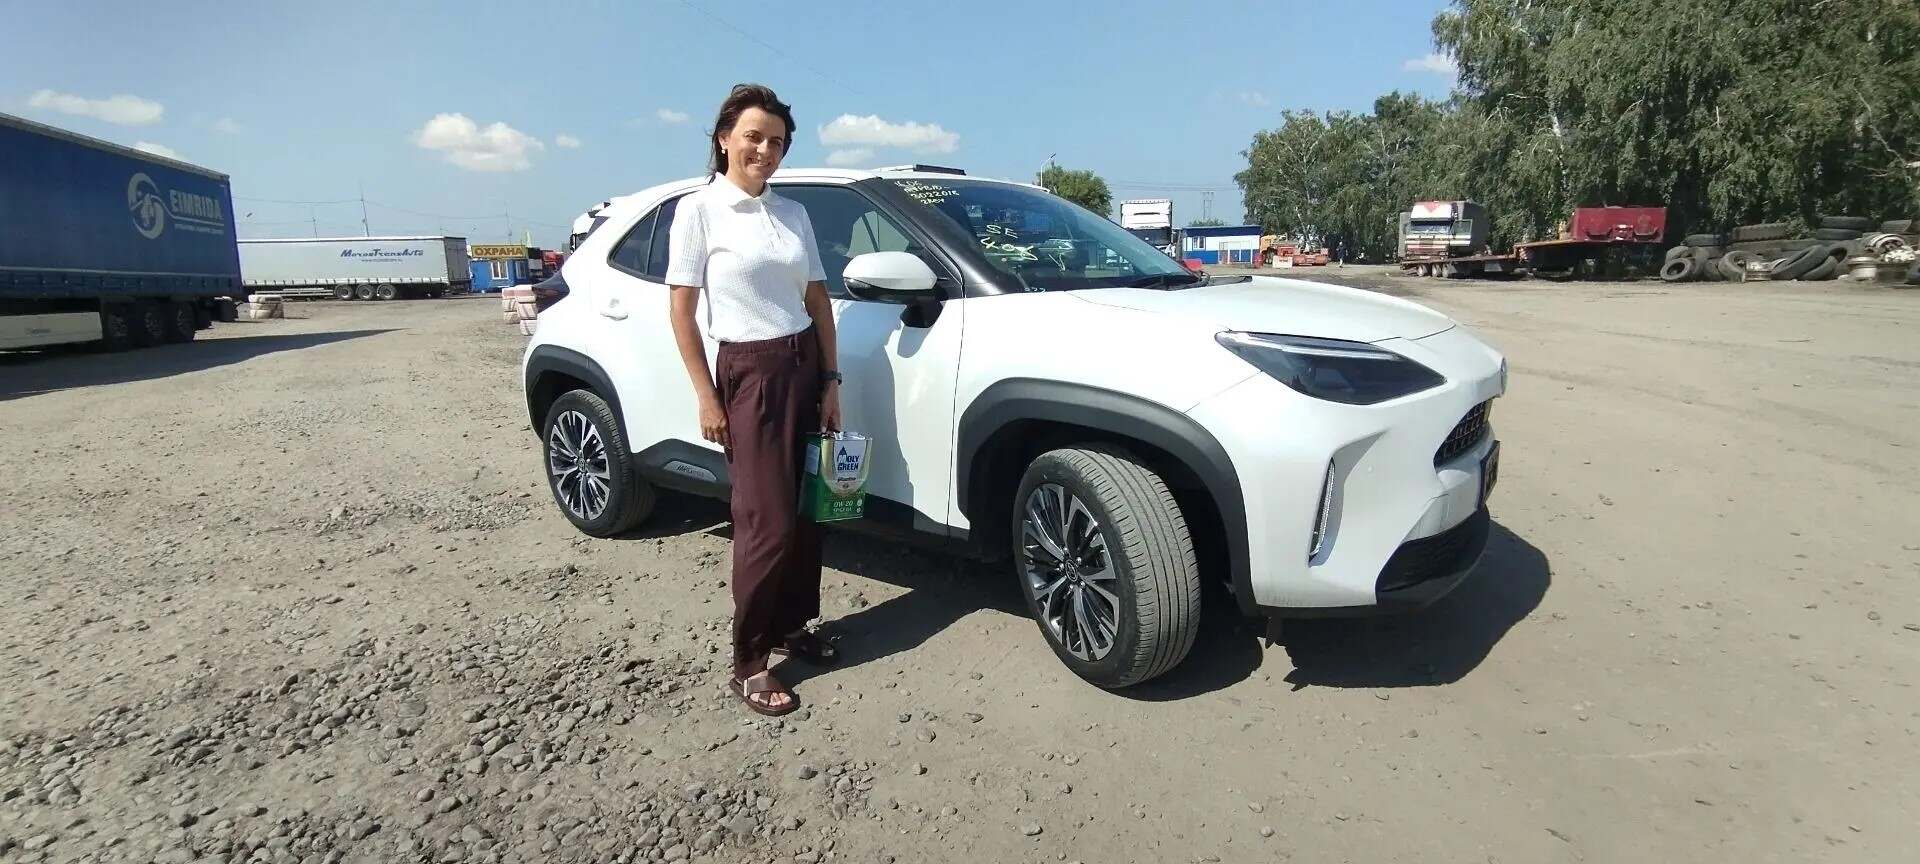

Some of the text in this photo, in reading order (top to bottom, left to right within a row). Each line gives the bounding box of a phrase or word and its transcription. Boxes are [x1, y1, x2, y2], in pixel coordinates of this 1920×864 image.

[170, 189, 224, 219] EIMRIDA
[986, 224, 1018, 238] SE
[474, 247, 523, 256] ОХРАНА
